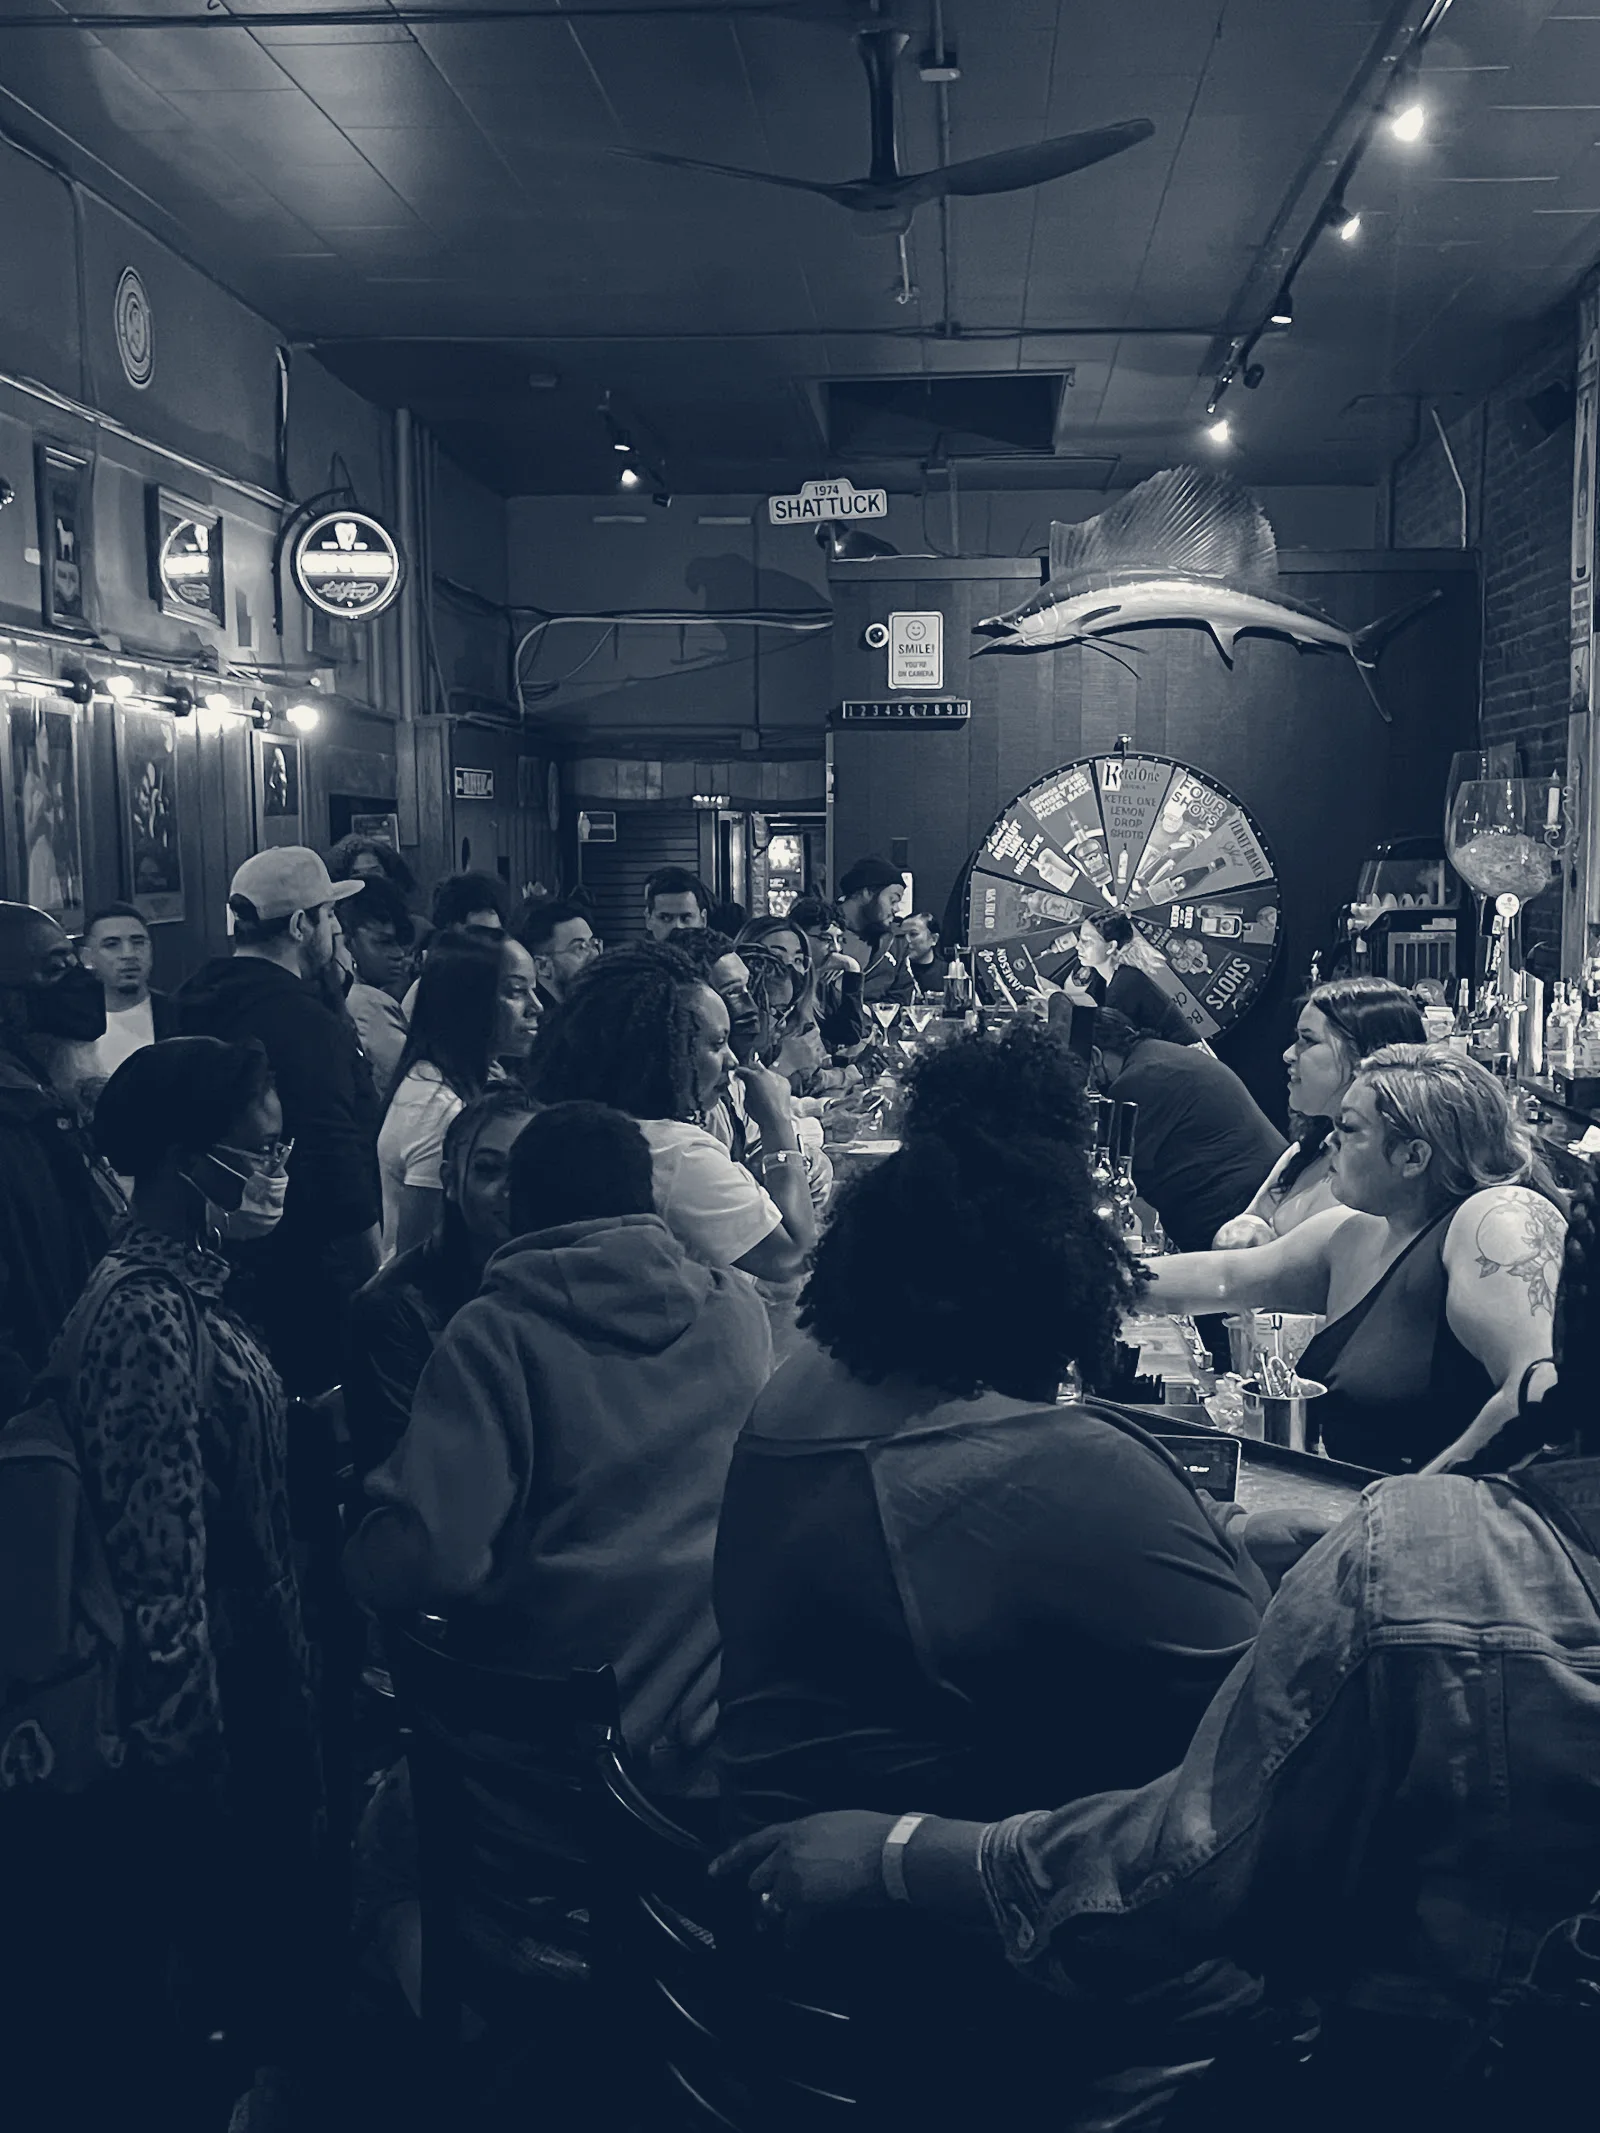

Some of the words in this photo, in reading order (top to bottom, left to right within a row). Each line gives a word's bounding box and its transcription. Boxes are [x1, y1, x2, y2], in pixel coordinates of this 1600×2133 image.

[814, 484, 839, 496] 1974
[775, 494, 881, 519] SHATTUCK
[898, 643, 935, 654] SMILE!
[848, 705, 854, 717] 1
[860, 705, 867, 717] 2
[873, 704, 879, 716] 3
[885, 704, 891, 716] 4
[897, 704, 904, 716] 5
[909, 704, 916, 717] 6
[922, 704, 928, 716] 7
[934, 704, 940, 715] 8
[946, 703, 953, 715] 9
[956, 703, 967, 715] 10
[1105, 763, 1137, 788] Ketel
[1138, 767, 1161, 783] One
[1032, 790, 1068, 813] WHISKY
[1068, 776, 1089, 796] AND
[1067, 782, 1092, 803] BACK
[1104, 794, 1133, 805] KETEL
[1137, 796, 1157, 807] ONE
[1179, 777, 1228, 816] FOUR
[1110, 806, 1145, 817] LEMON
[1171, 791, 1220, 828] SHOTS
[1114, 817, 1143, 828] DROP
[992, 818, 1022, 861] ABSOLUT
[1004, 834, 1025, 858] LIME
[1013, 853, 1032, 876] HIGH
[1027, 833, 1044, 855] LIFE
[996, 947, 1025, 991] JAMESON
[1205, 957, 1251, 1010] SHOTS
